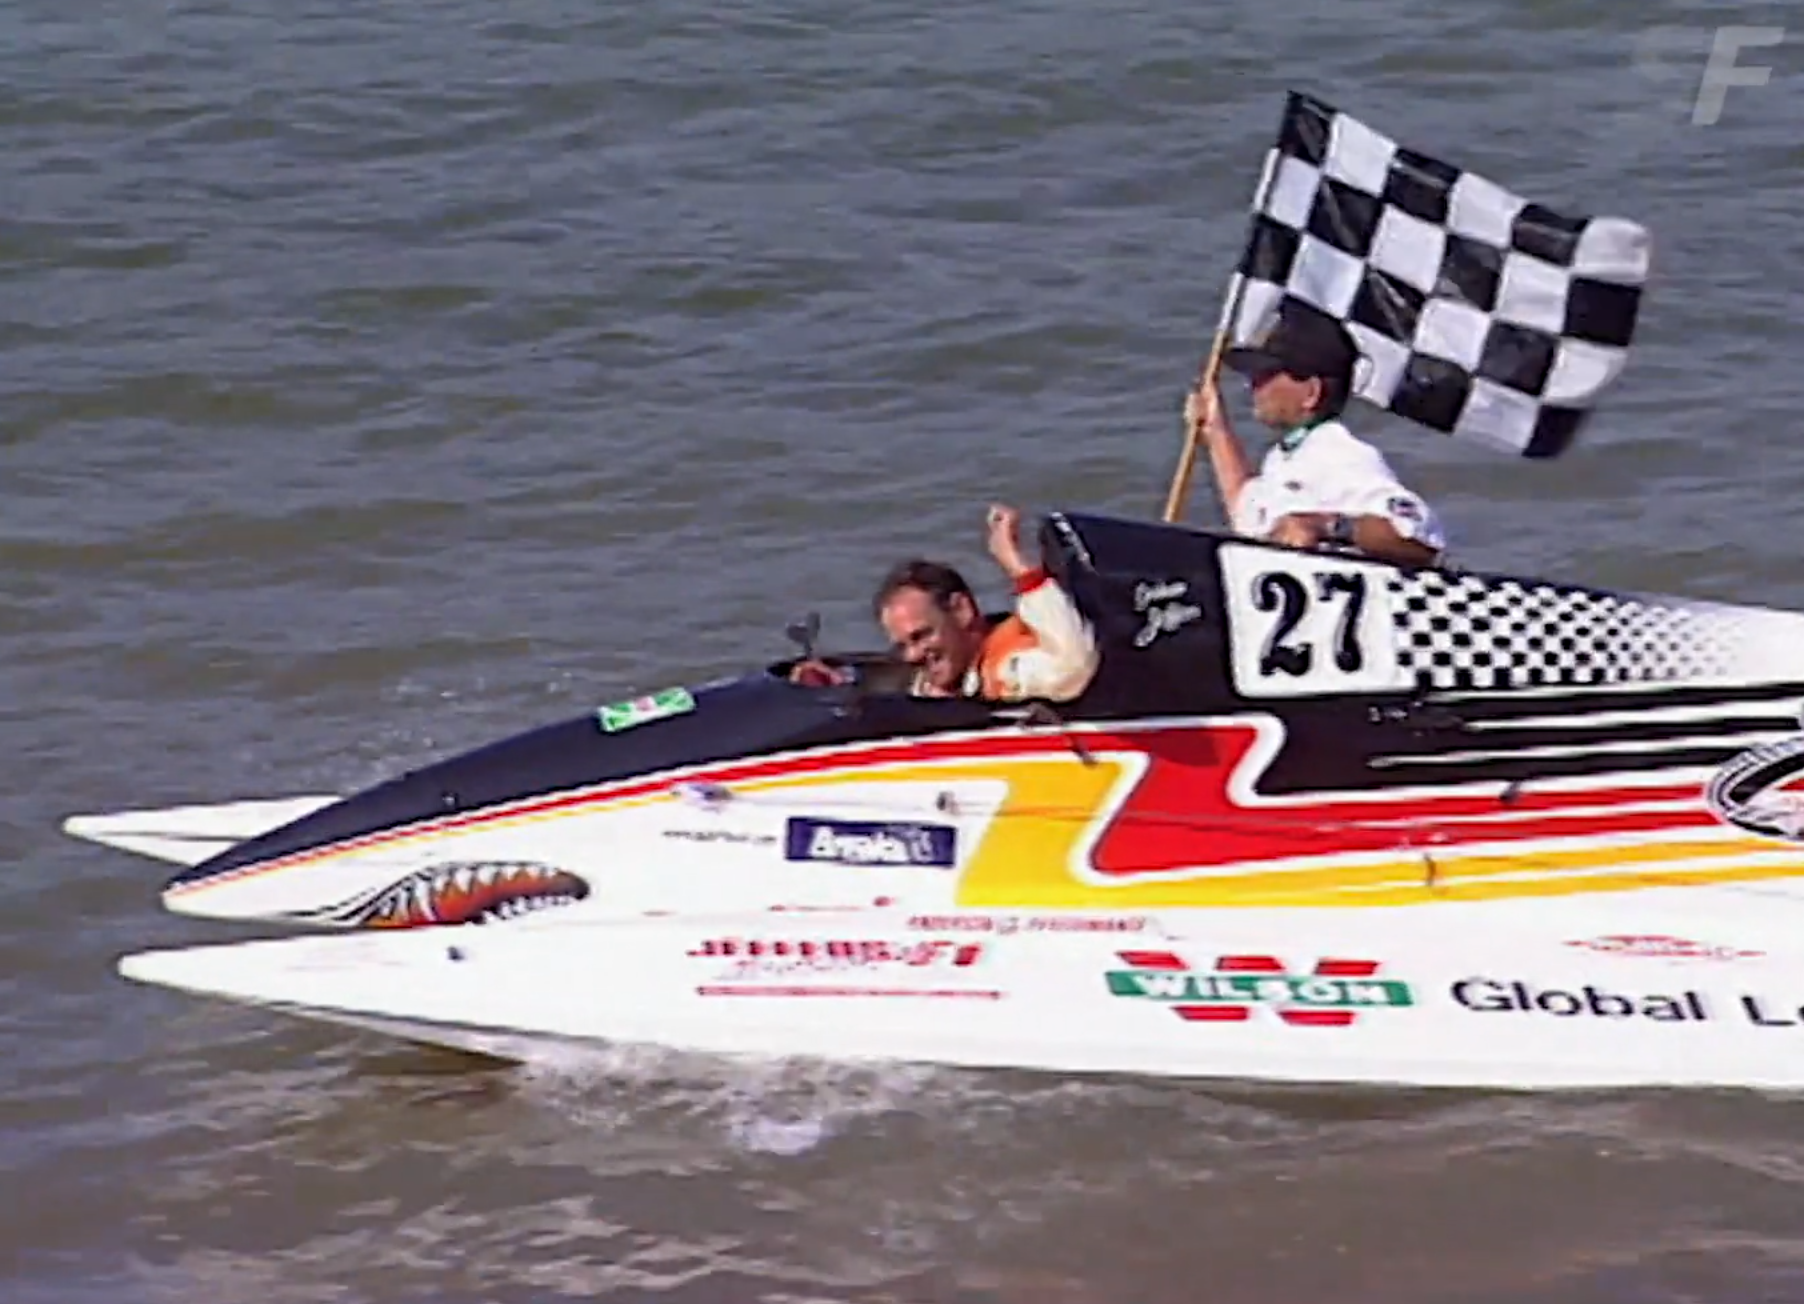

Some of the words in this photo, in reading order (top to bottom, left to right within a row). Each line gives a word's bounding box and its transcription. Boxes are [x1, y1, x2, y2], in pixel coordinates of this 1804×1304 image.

[1251, 570, 1367, 677] 27
[1130, 972, 1389, 1005] WILSON
[1450, 976, 1707, 1022] Global
